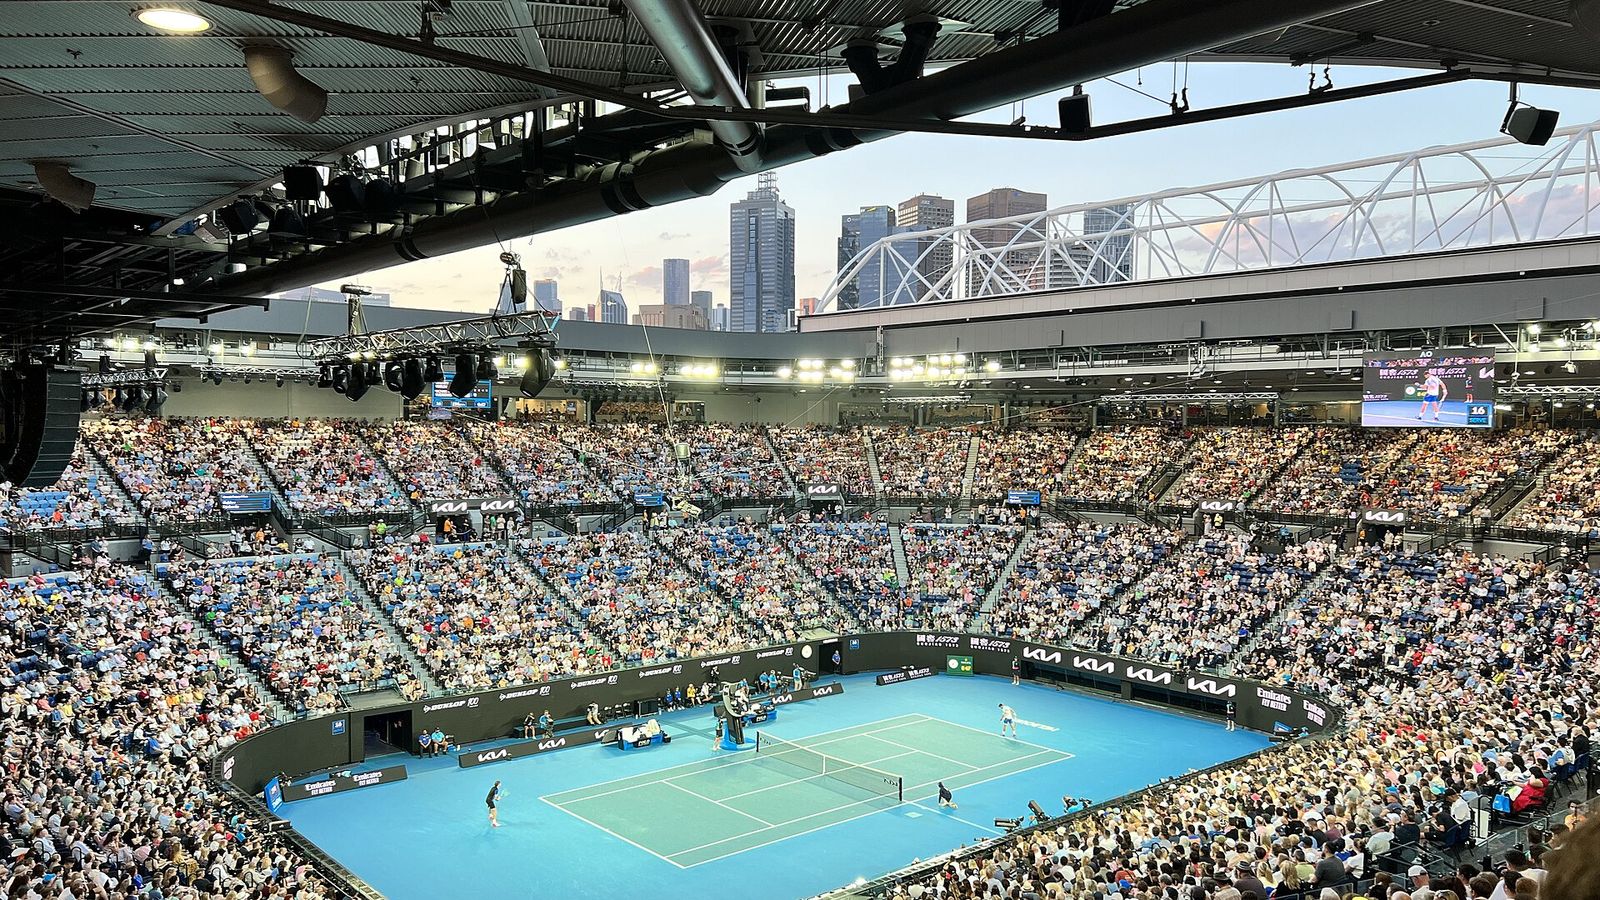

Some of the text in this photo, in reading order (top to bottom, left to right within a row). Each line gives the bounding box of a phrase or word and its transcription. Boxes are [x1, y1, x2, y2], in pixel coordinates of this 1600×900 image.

[1471, 406, 1486, 415] 16
[808, 485, 837, 494] KIA
[432, 501, 468, 512] KIA
[481, 500, 515, 511] KIA
[1201, 501, 1233, 511] KIA
[1365, 511, 1404, 522] KIA
[1023, 646, 1062, 664] KIA
[1073, 655, 1115, 674] KIA
[1126, 666, 1172, 685] KIA
[576, 677, 607, 687] DUNLOP
[1187, 677, 1236, 697] KIA
[506, 688, 539, 699] DUNLOP
[813, 686, 833, 696] KIA
[1257, 687, 1292, 704] Emirates
[430, 700, 467, 711] DUNLOP
[538, 737, 566, 750] KIA
[477, 749, 507, 762] KIA
[352, 771, 383, 782] Emirates
[304, 780, 337, 791] Emirates
